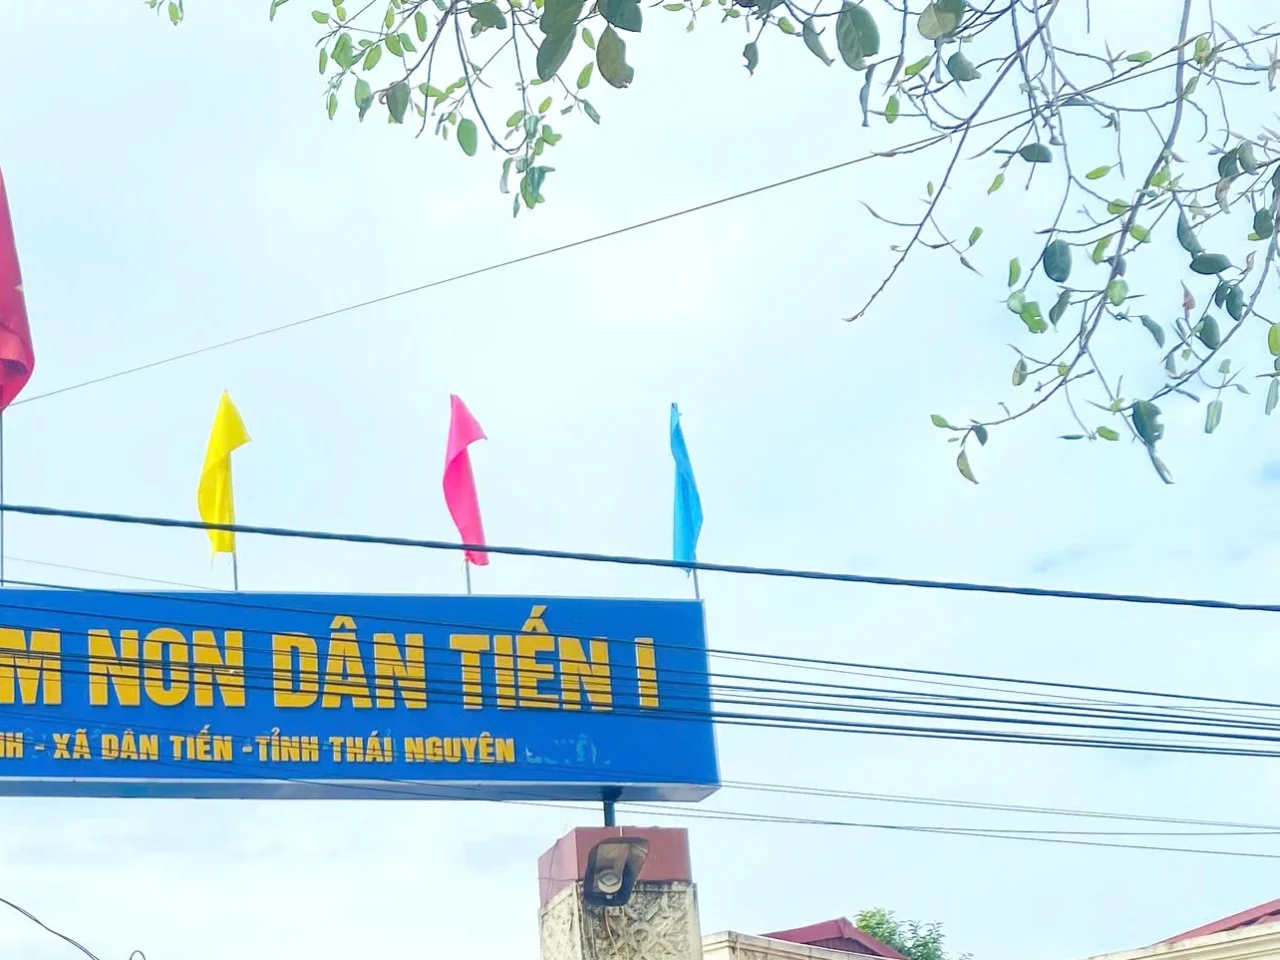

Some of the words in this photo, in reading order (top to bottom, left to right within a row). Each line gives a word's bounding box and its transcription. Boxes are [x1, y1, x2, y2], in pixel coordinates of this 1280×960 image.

[88, 627, 246, 707] NON
[272, 615, 428, 710] DÂN
[450, 604, 612, 711] TIẾN
[634, 637, 661, 709] I
[52, 728, 92, 760] XÃ
[101, 728, 159, 761] DÂN
[170, 724, 233, 761] TIẾN
[328, 729, 394, 763] THÁI
[404, 731, 516, 763] NGUYÊN
